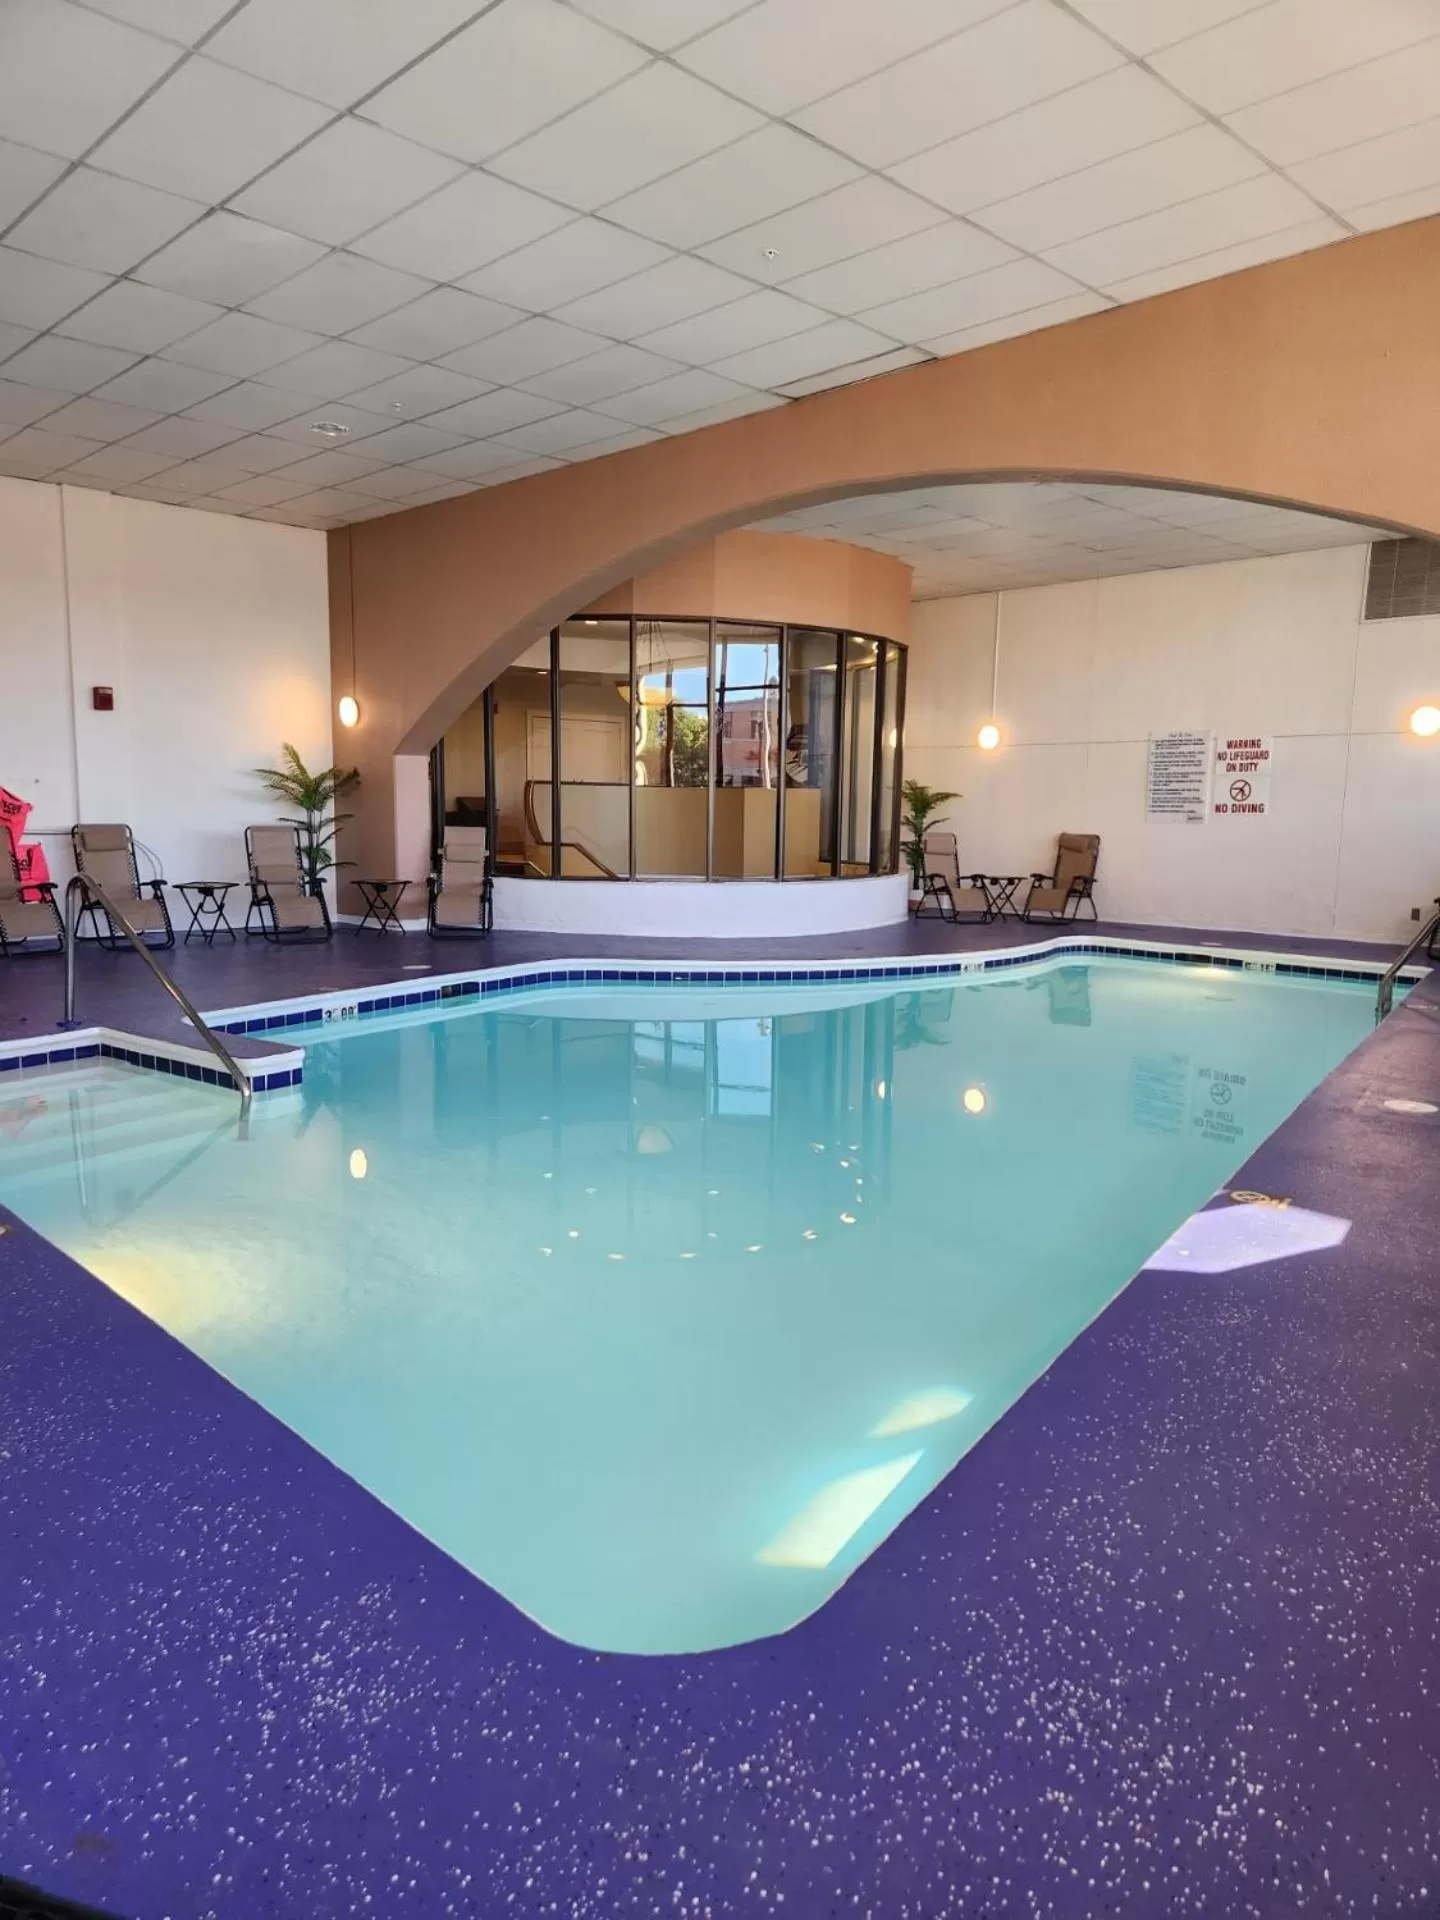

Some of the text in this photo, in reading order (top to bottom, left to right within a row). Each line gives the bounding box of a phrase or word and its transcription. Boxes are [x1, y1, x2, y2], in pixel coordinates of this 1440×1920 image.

[1226, 739, 1262, 749] WARNING
[1217, 750, 1269, 761] NO LIFEGUARD
[1226, 762, 1259, 773] ON DUTY
[1215, 803, 1265, 813] NO DIVING
